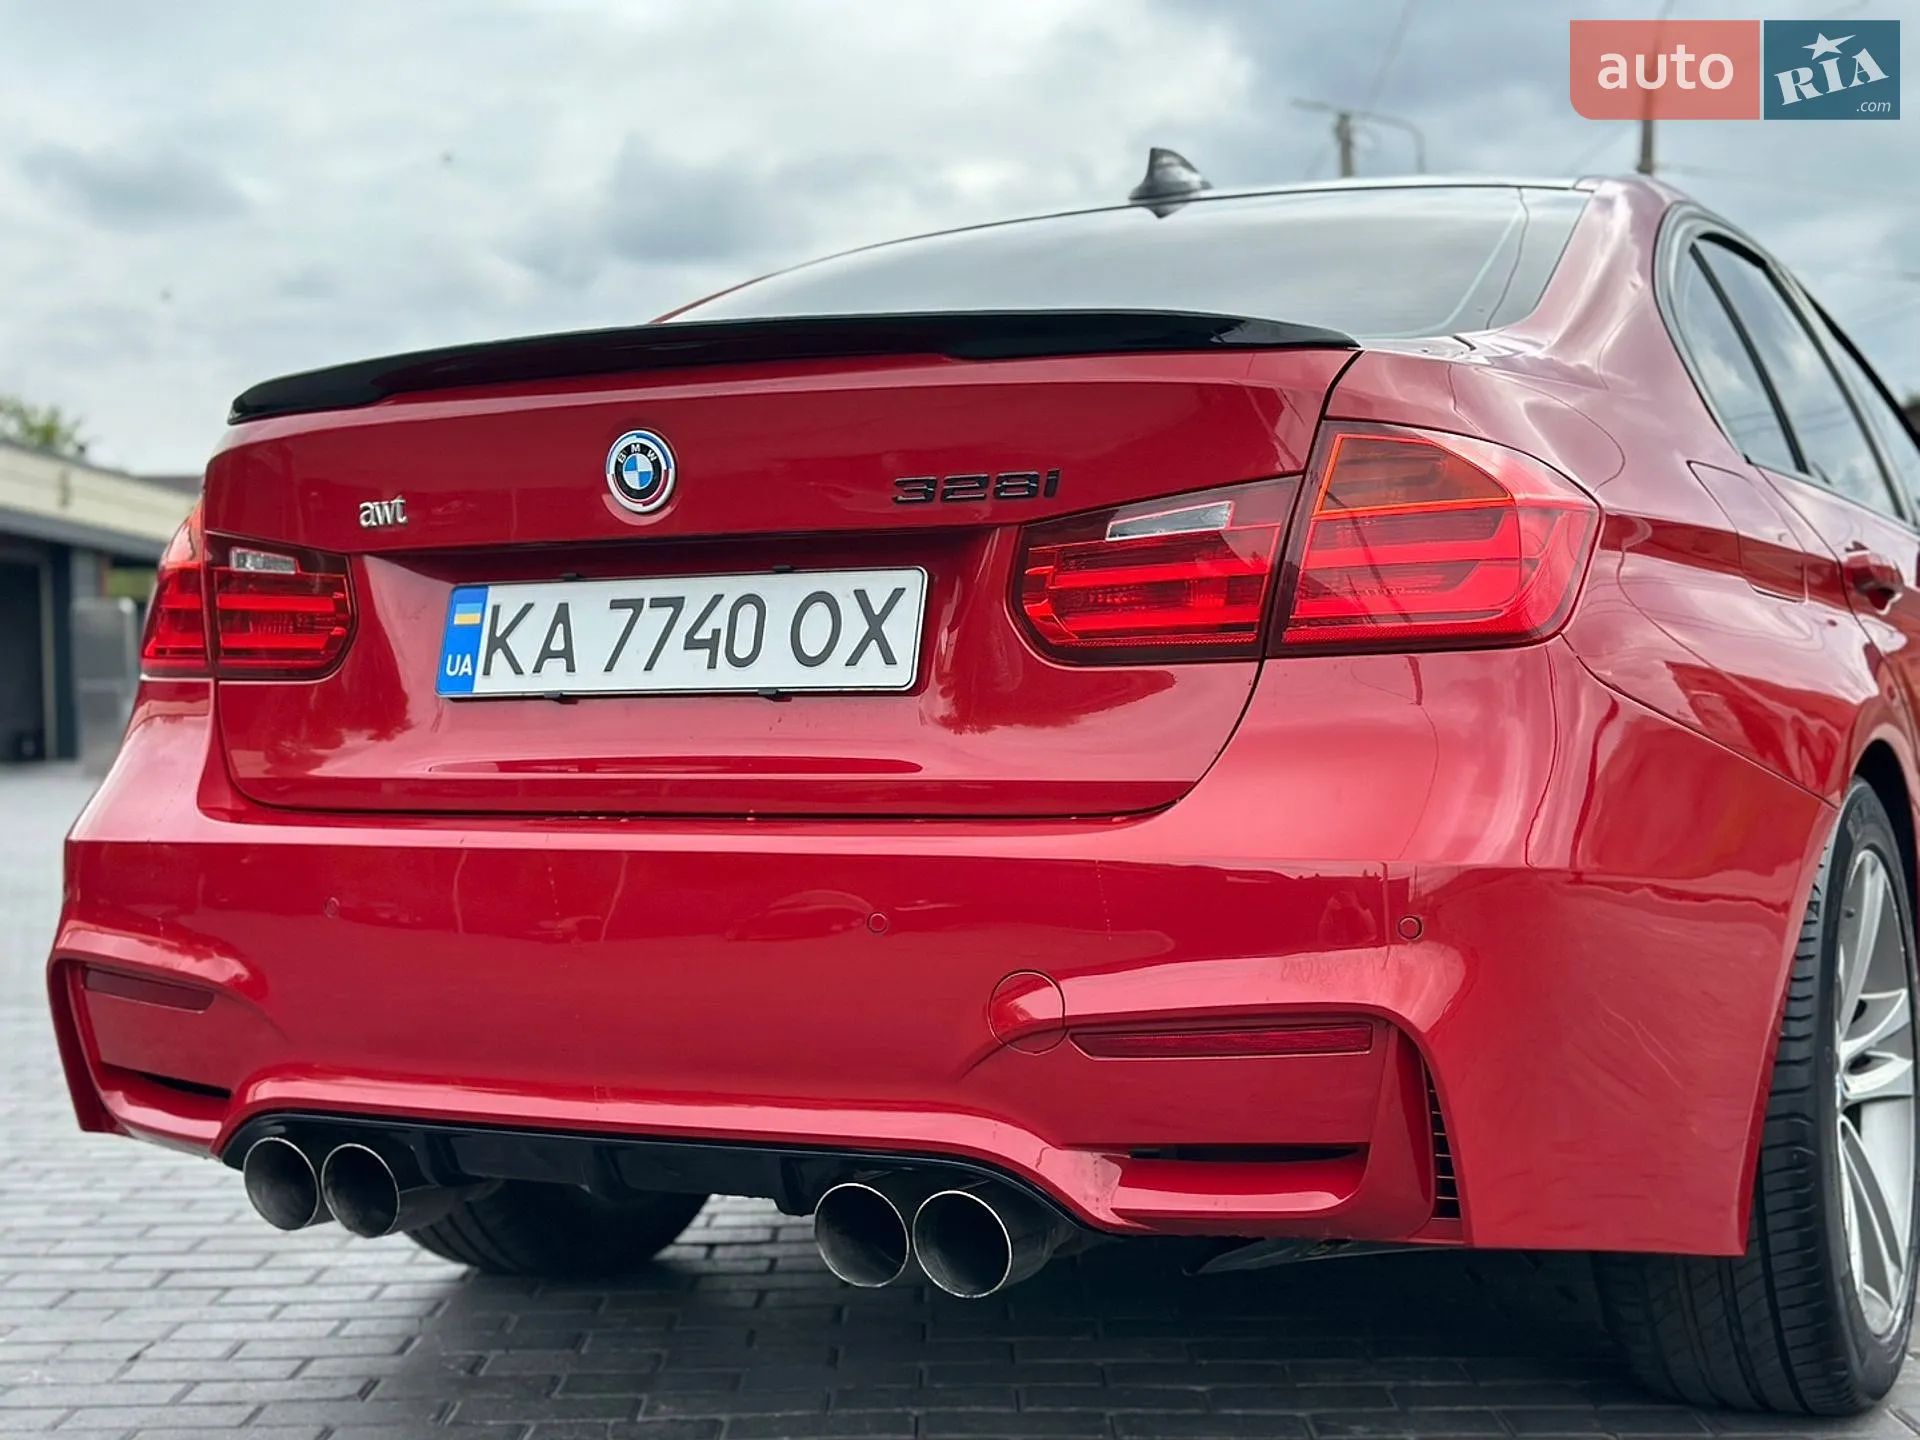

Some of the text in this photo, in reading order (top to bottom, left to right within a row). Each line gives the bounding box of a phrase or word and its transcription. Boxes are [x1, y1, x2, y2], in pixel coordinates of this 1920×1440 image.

[617, 443, 658, 463] BMW
[359, 494, 408, 527] awt
[481, 587, 906, 676] KA 7740 OX
[445, 653, 473, 677] UA
